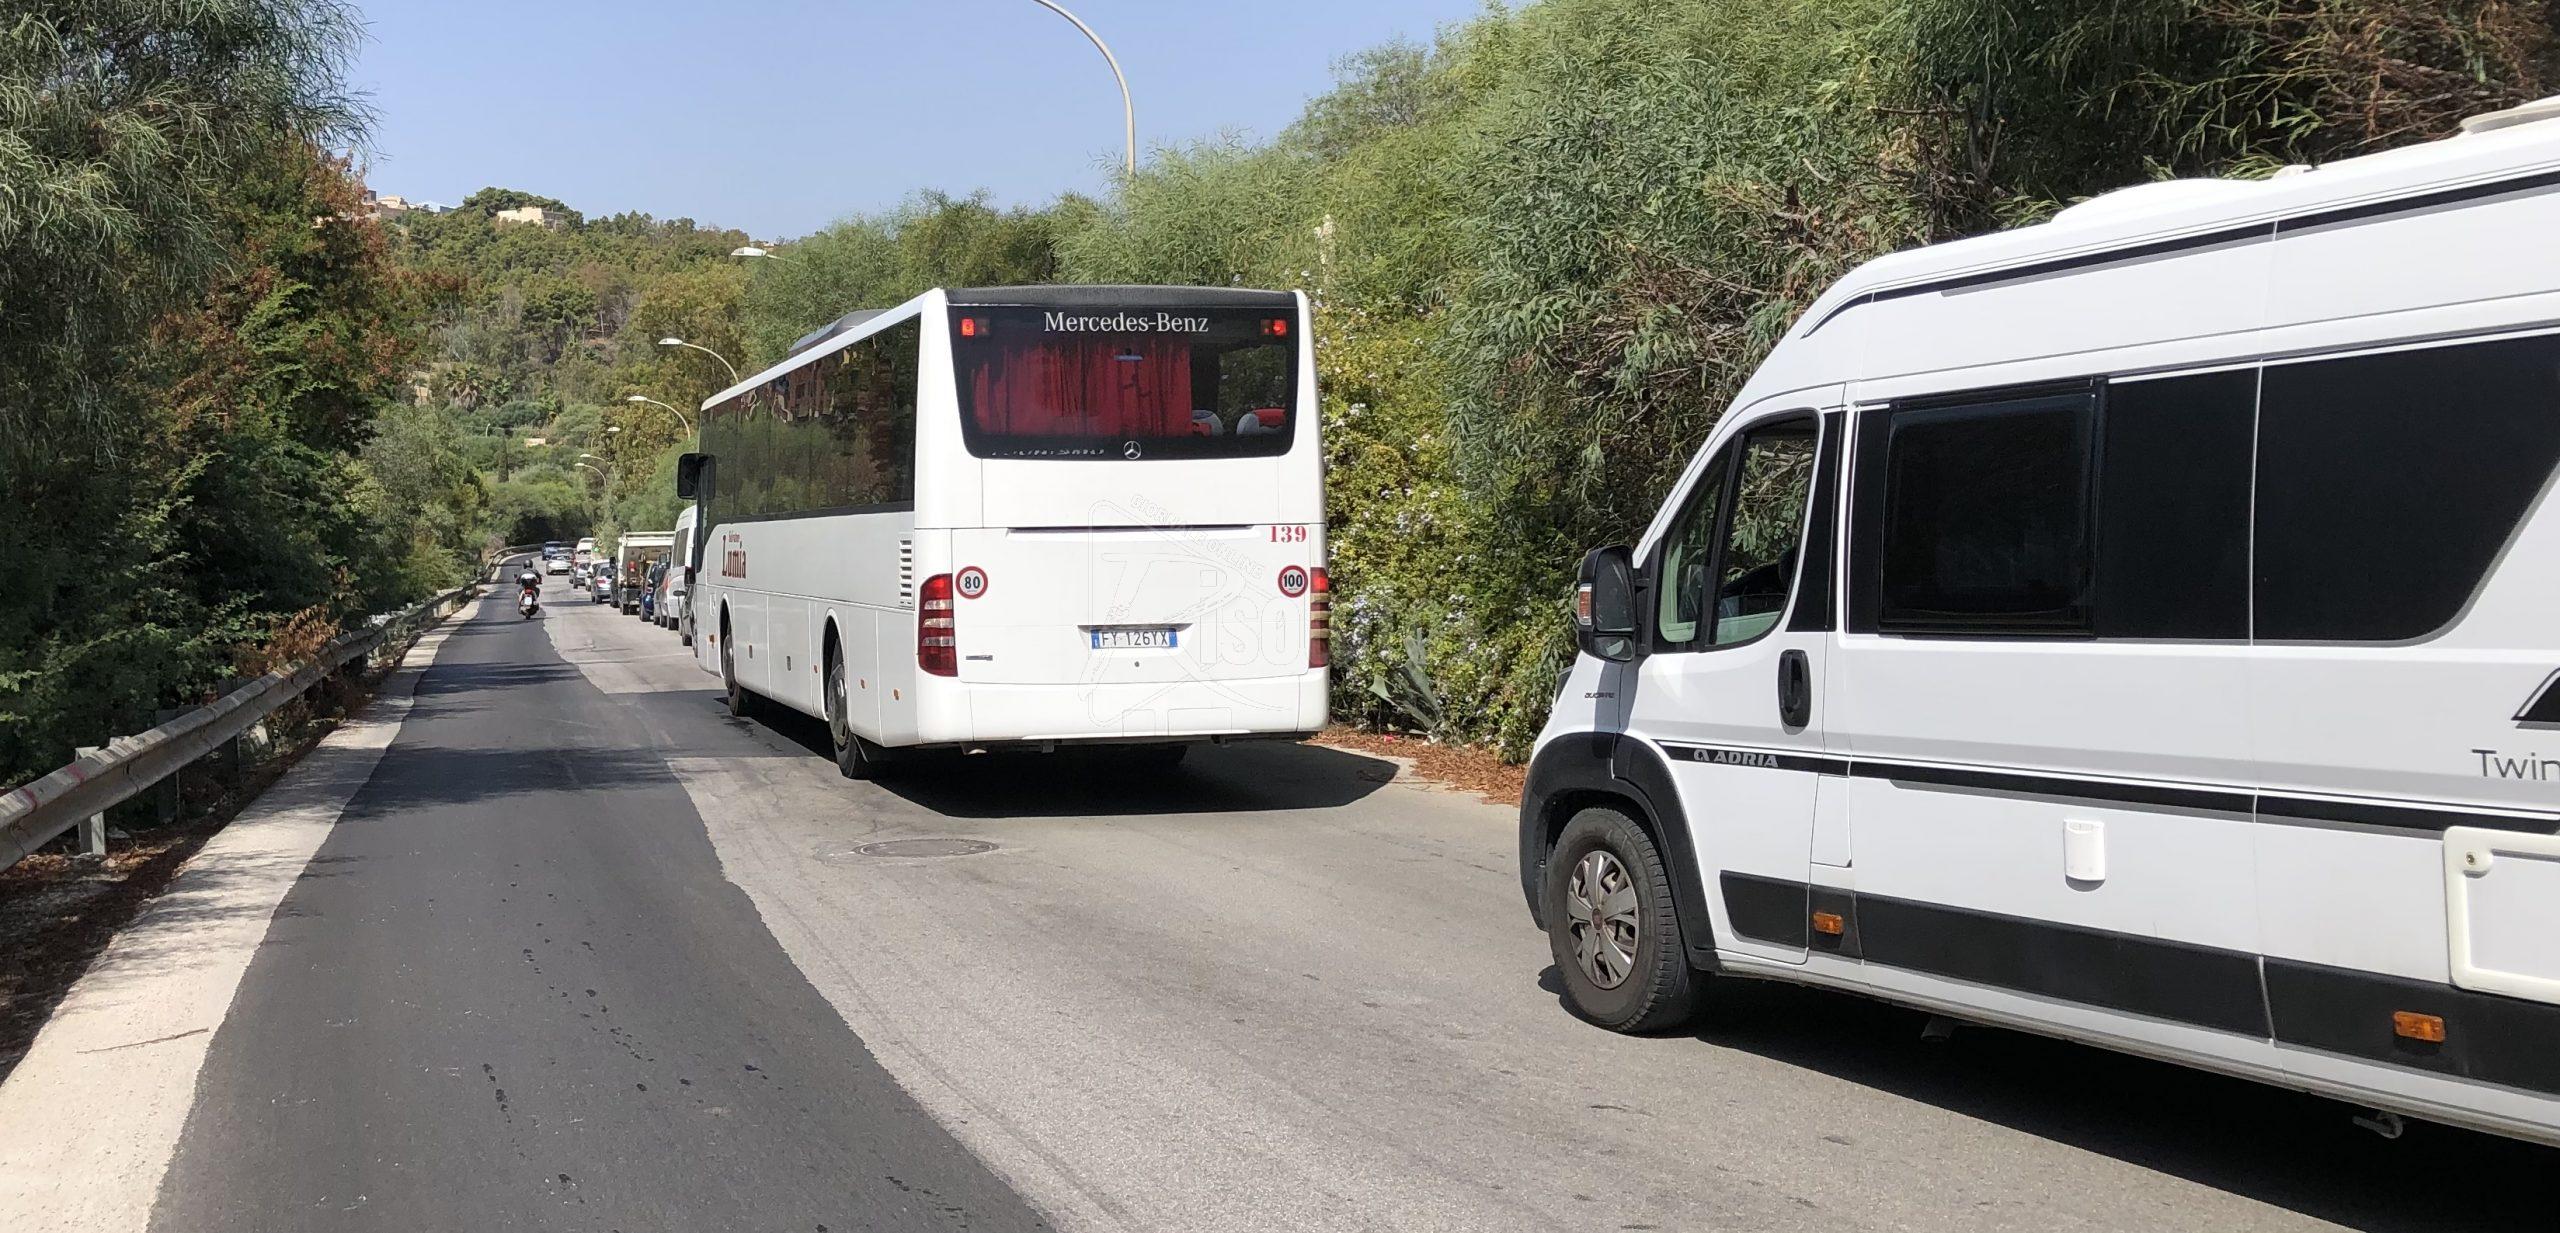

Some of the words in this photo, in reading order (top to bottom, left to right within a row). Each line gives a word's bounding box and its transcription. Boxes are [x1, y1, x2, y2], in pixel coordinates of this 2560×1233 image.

[1044, 311, 1209, 333] Mercedes-Benz
[1269, 526, 1307, 543] 139
[721, 535, 747, 579] Lumia
[964, 576, 981, 589] 80
[1283, 574, 1303, 588] 100
[1101, 631, 1117, 646] FY
[1126, 631, 1168, 646] 126YX
[1714, 750, 1779, 768] ADRIA
